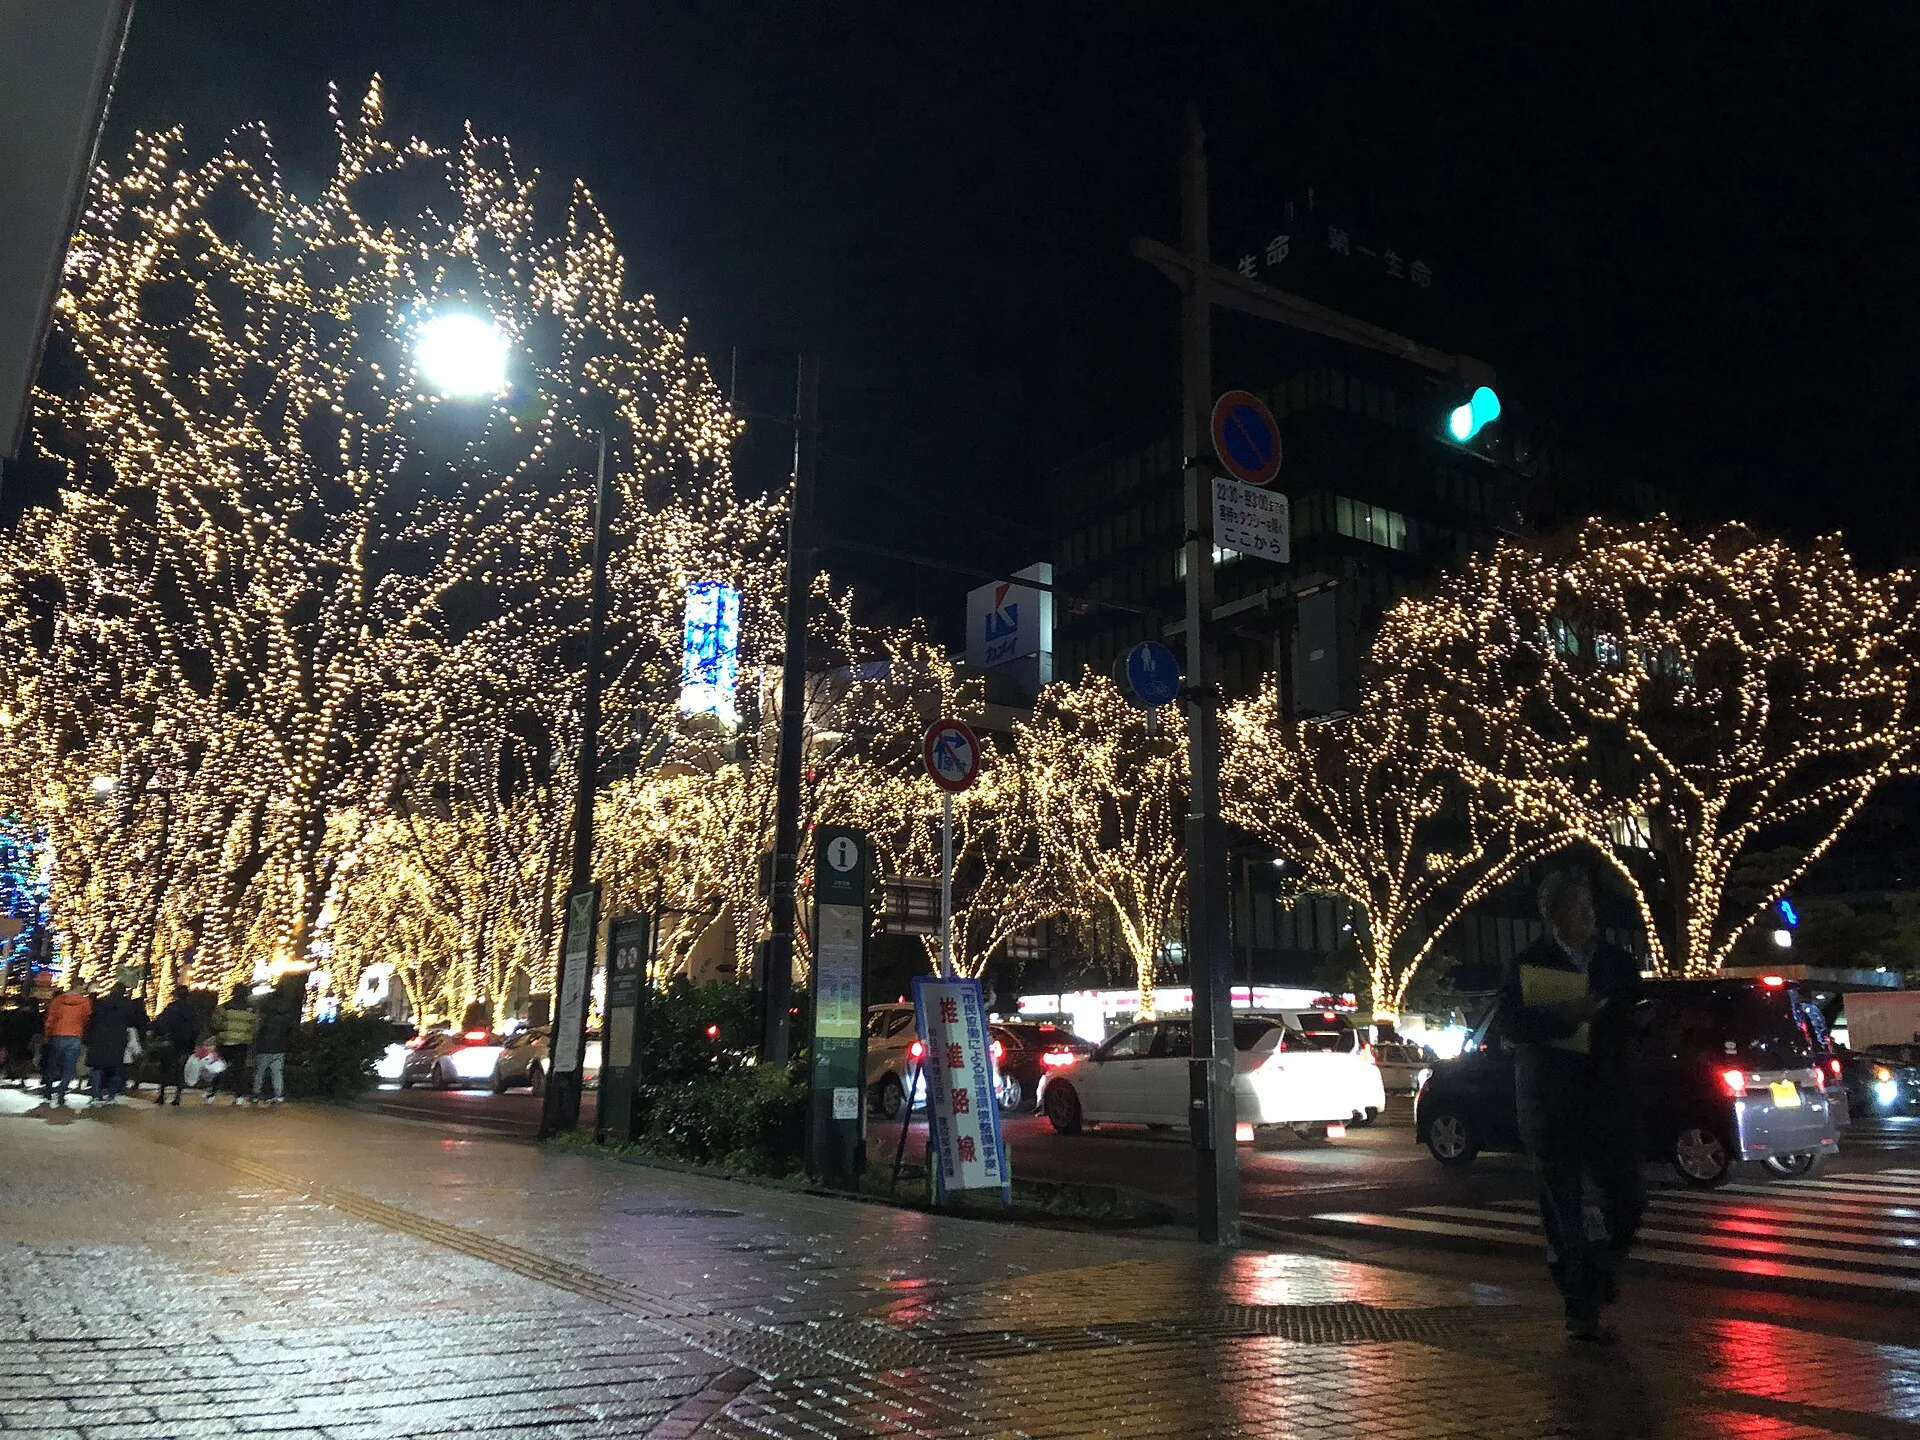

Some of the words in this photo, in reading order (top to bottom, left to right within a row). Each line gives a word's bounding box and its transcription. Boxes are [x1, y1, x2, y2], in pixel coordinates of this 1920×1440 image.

[1237, 234, 1290, 279] 生命
[1328, 224, 1432, 288] 第一生命
[1224, 527, 1281, 555] ここから
[986, 637, 1018, 663] カメイ
